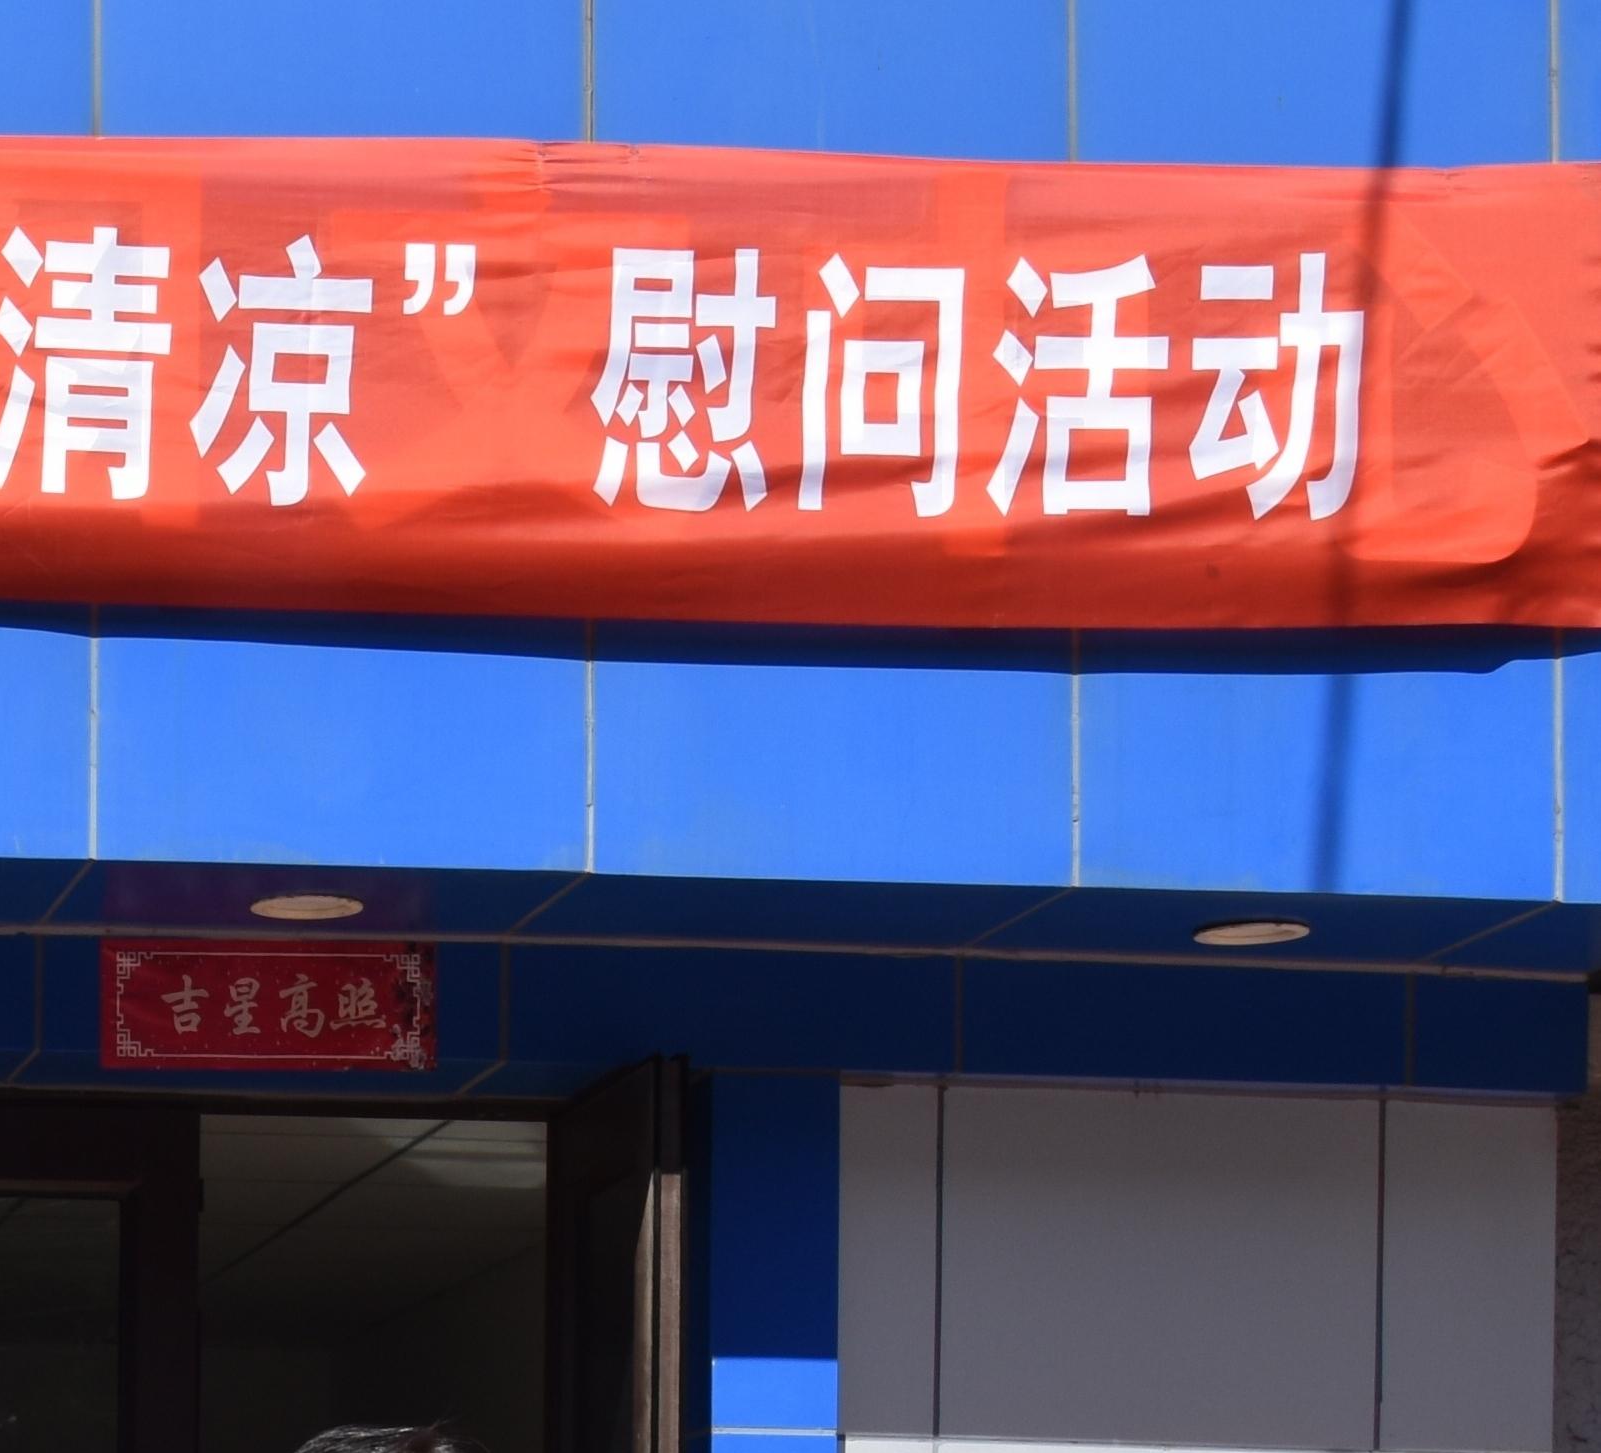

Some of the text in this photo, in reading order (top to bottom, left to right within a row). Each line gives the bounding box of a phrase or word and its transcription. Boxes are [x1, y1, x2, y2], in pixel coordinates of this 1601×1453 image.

[591, 247, 1365, 521] 慰问活动
[160, 974, 387, 1038] 吉星高照
